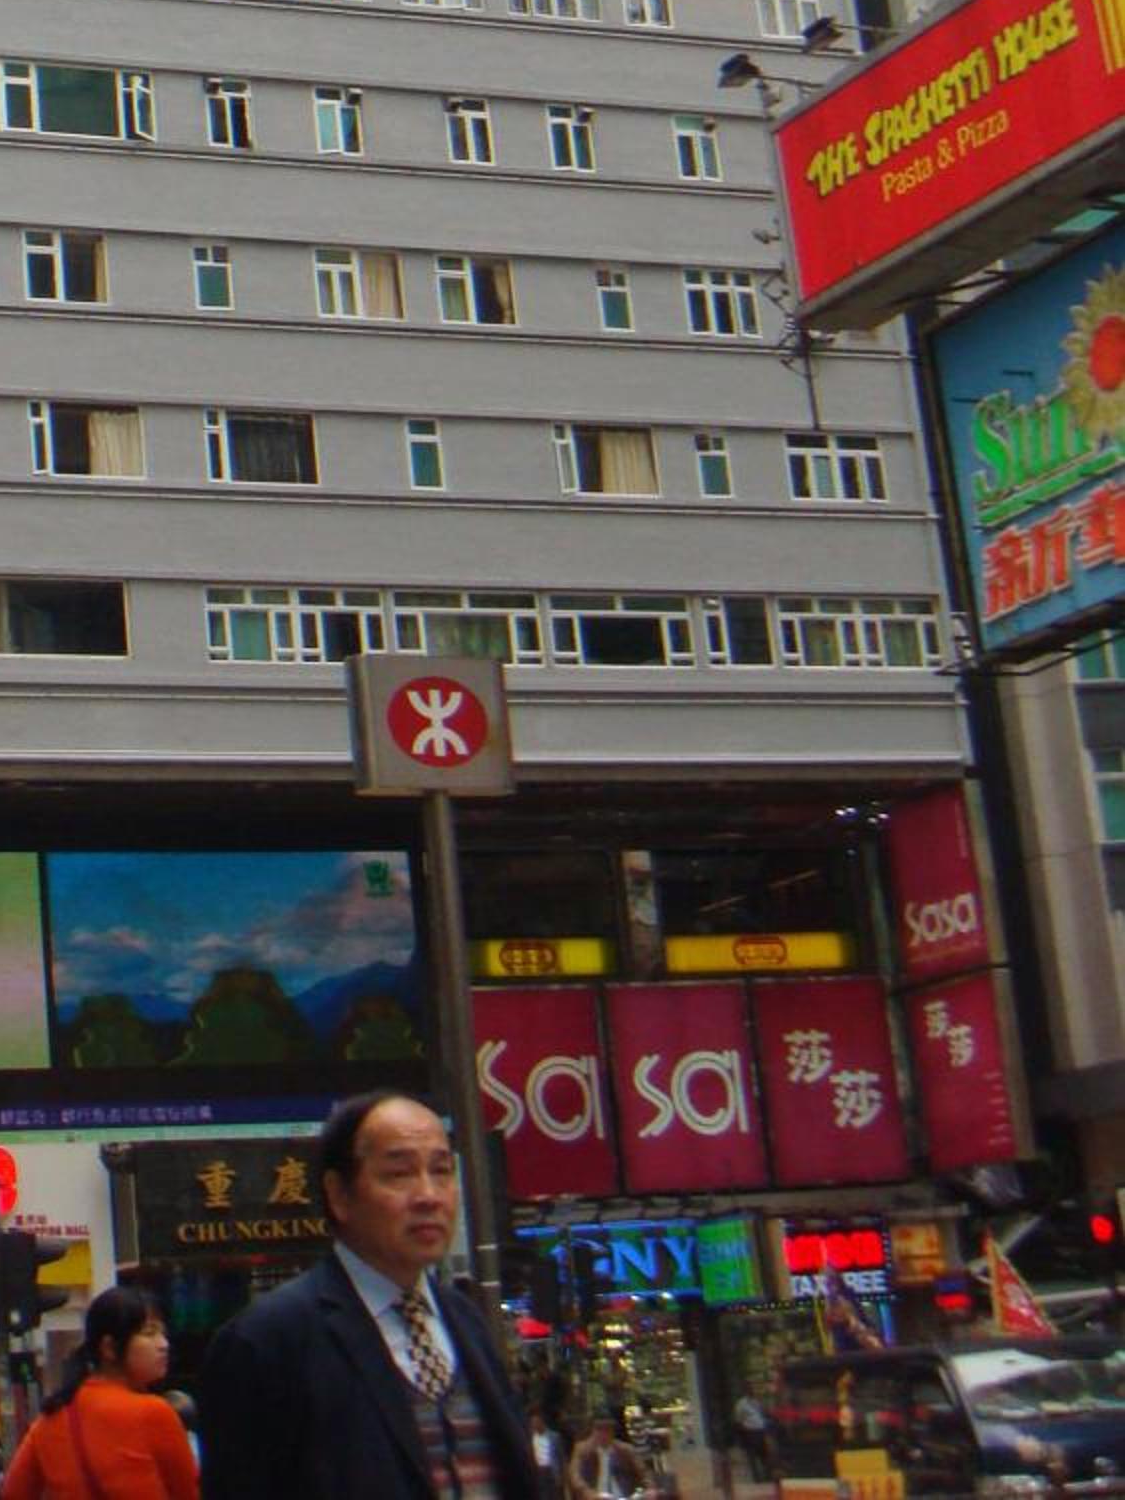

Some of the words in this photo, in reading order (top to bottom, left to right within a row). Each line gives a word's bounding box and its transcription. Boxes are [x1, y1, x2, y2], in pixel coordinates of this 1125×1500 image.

[805, 132, 862, 197] THE
[863, 46, 992, 167] SPAGHETTI
[880, 155, 934, 202] Pasta
[936, 137, 955, 170] &
[956, 109, 1010, 156] Pizza
[839, 1269, 888, 1294] REE
